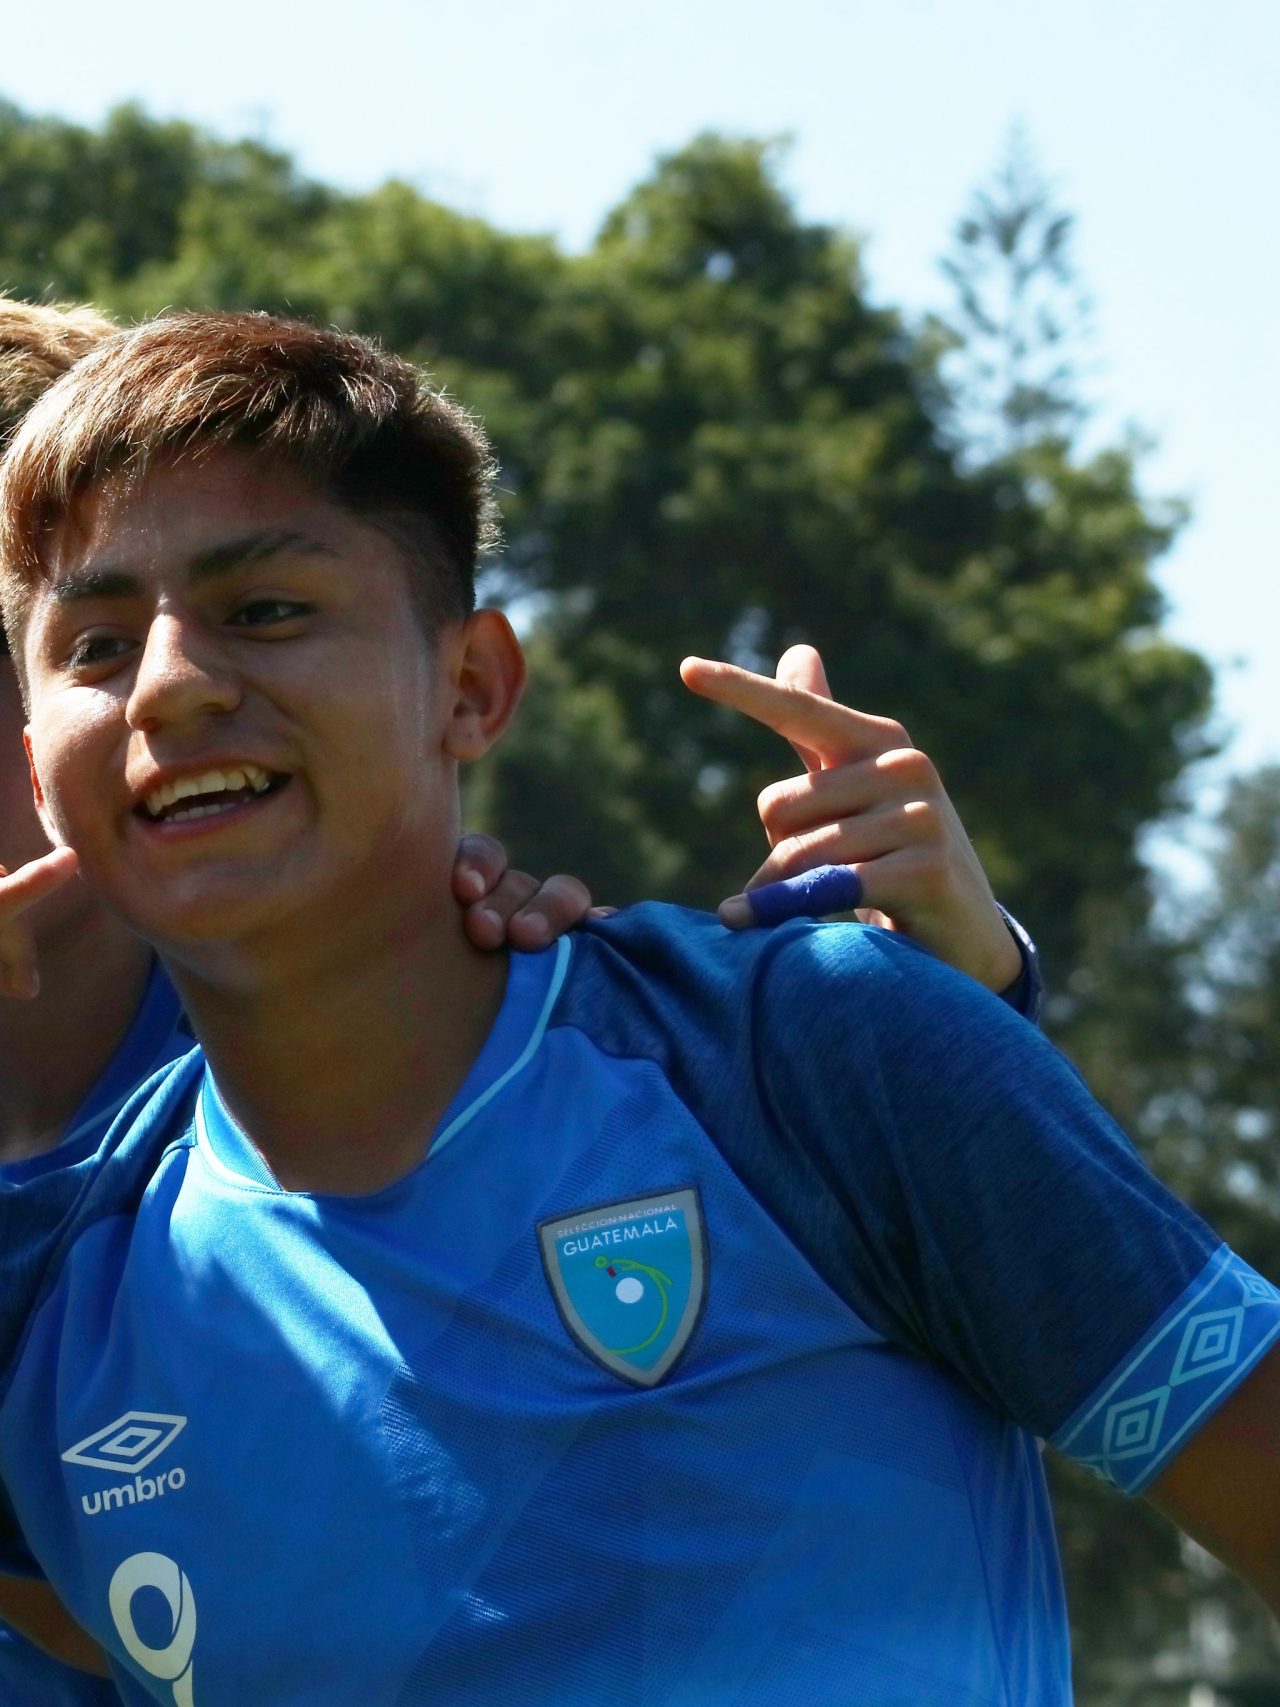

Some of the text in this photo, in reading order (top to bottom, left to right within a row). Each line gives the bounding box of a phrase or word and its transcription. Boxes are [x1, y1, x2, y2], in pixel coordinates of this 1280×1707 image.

[557, 1203, 678, 1238] SELECCION NACIONAL
[563, 1216, 678, 1256] GUATEMALA
[81, 1467, 187, 1515] umbro
